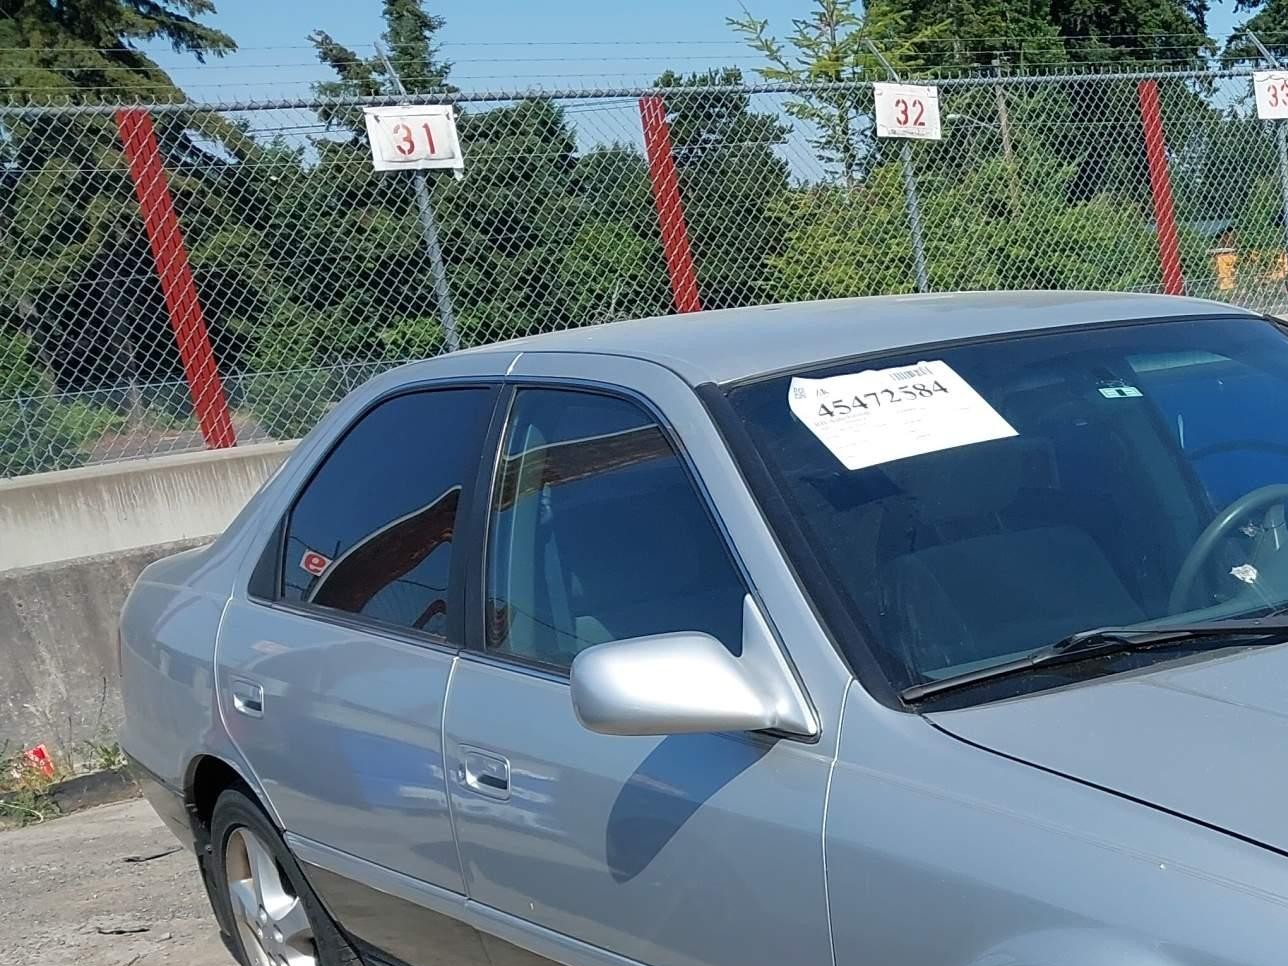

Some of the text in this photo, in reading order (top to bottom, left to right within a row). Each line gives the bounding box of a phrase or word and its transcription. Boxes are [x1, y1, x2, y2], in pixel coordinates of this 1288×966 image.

[895, 99, 925, 126] 32
[393, 123, 435, 155] 31
[818, 380, 949, 417] 45472584
